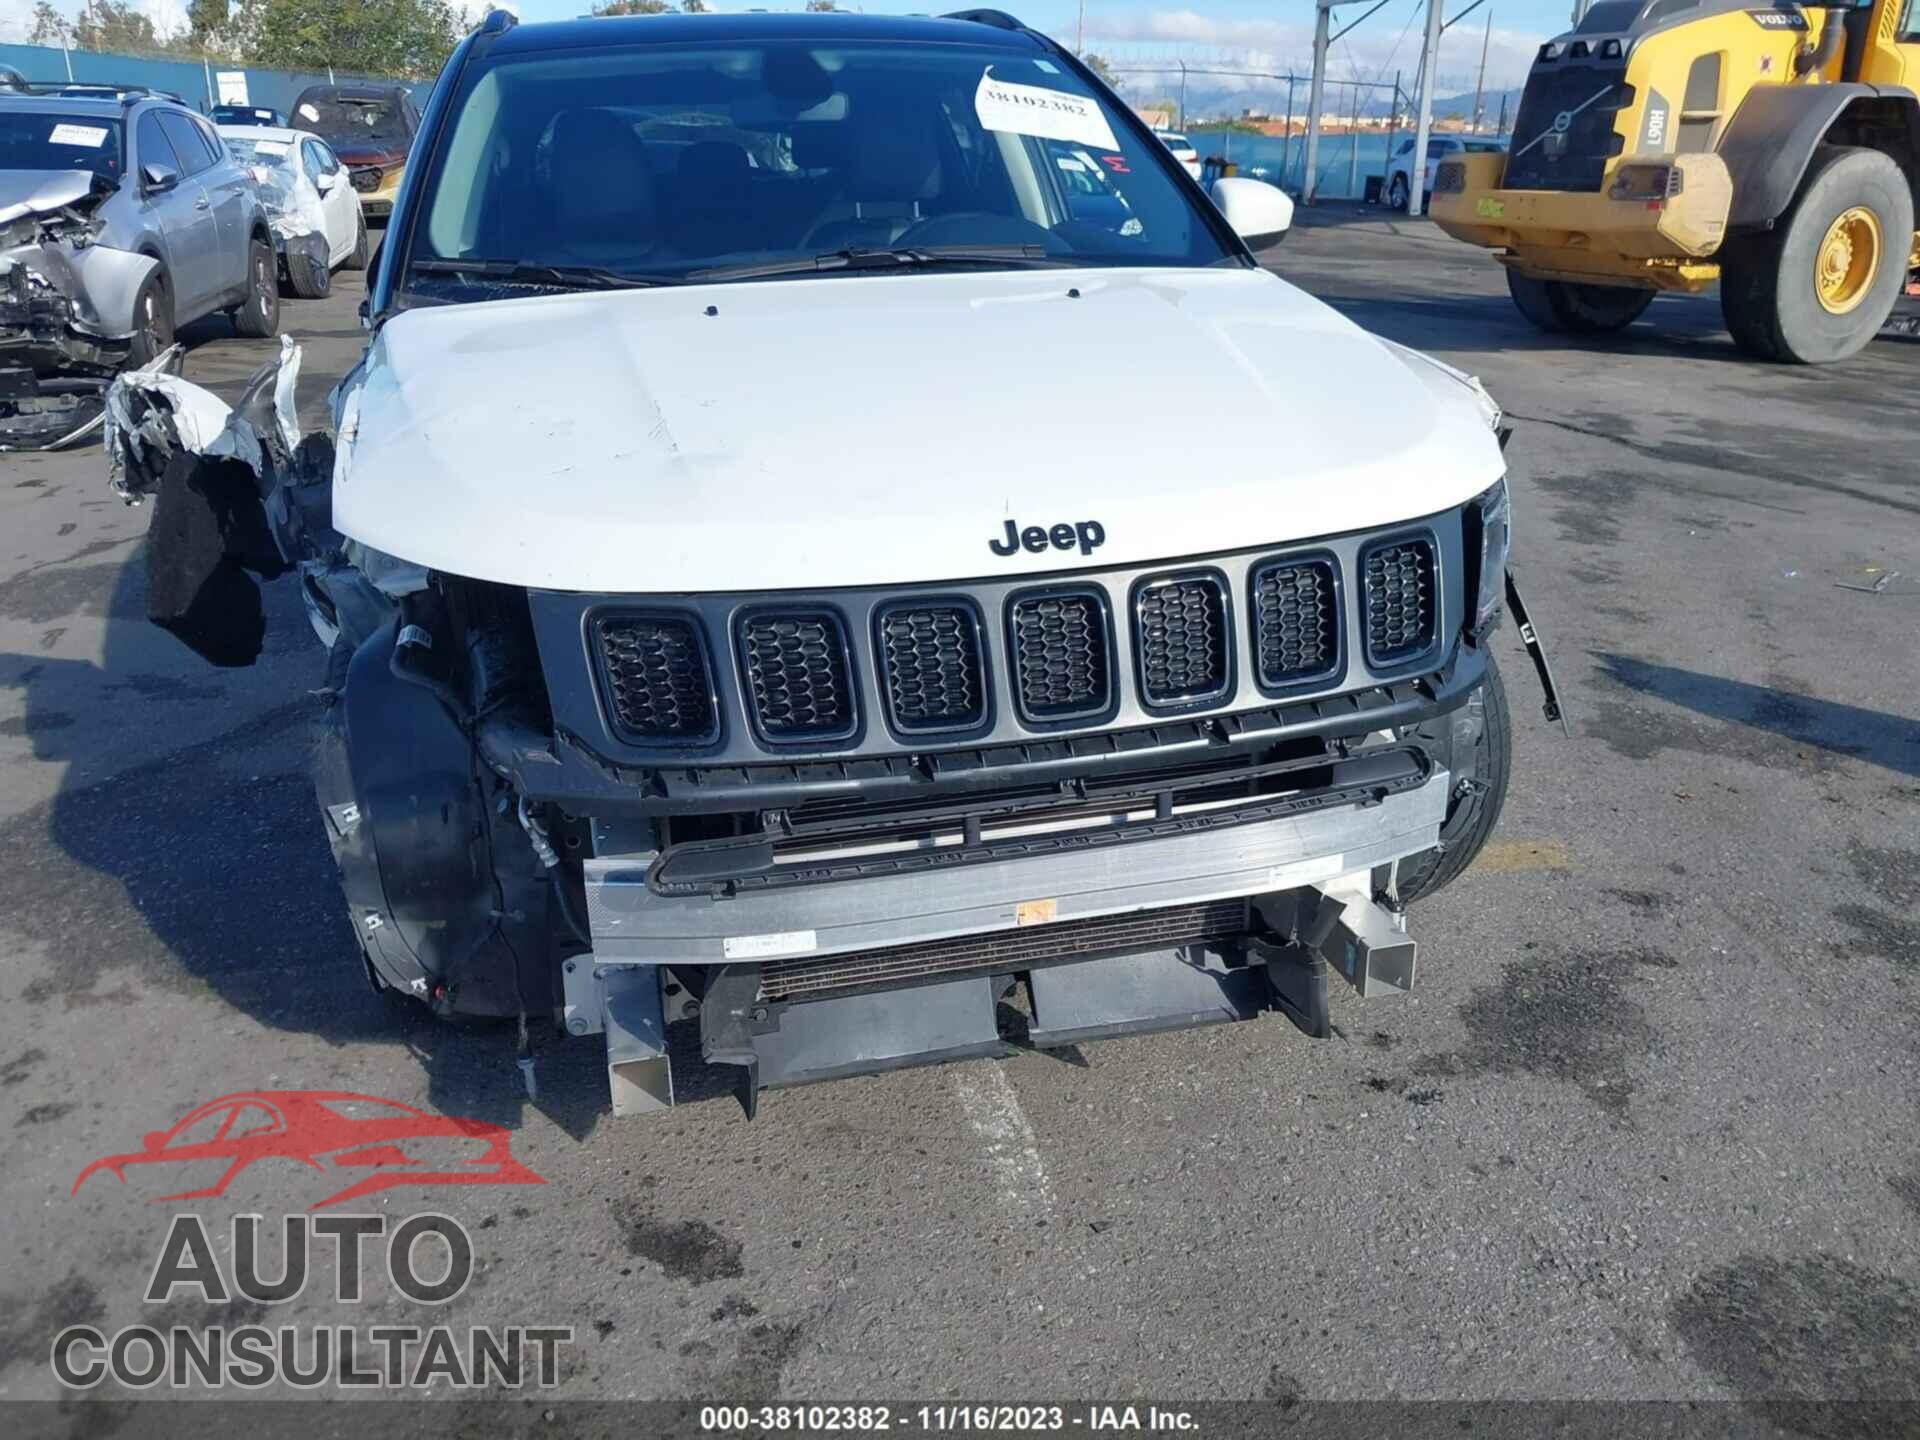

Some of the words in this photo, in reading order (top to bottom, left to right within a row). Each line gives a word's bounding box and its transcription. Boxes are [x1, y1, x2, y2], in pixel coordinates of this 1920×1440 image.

[1753, 14, 1803, 25] VOLVO
[1647, 109, 1665, 145] L90H
[988, 519, 1106, 556] Jeep
